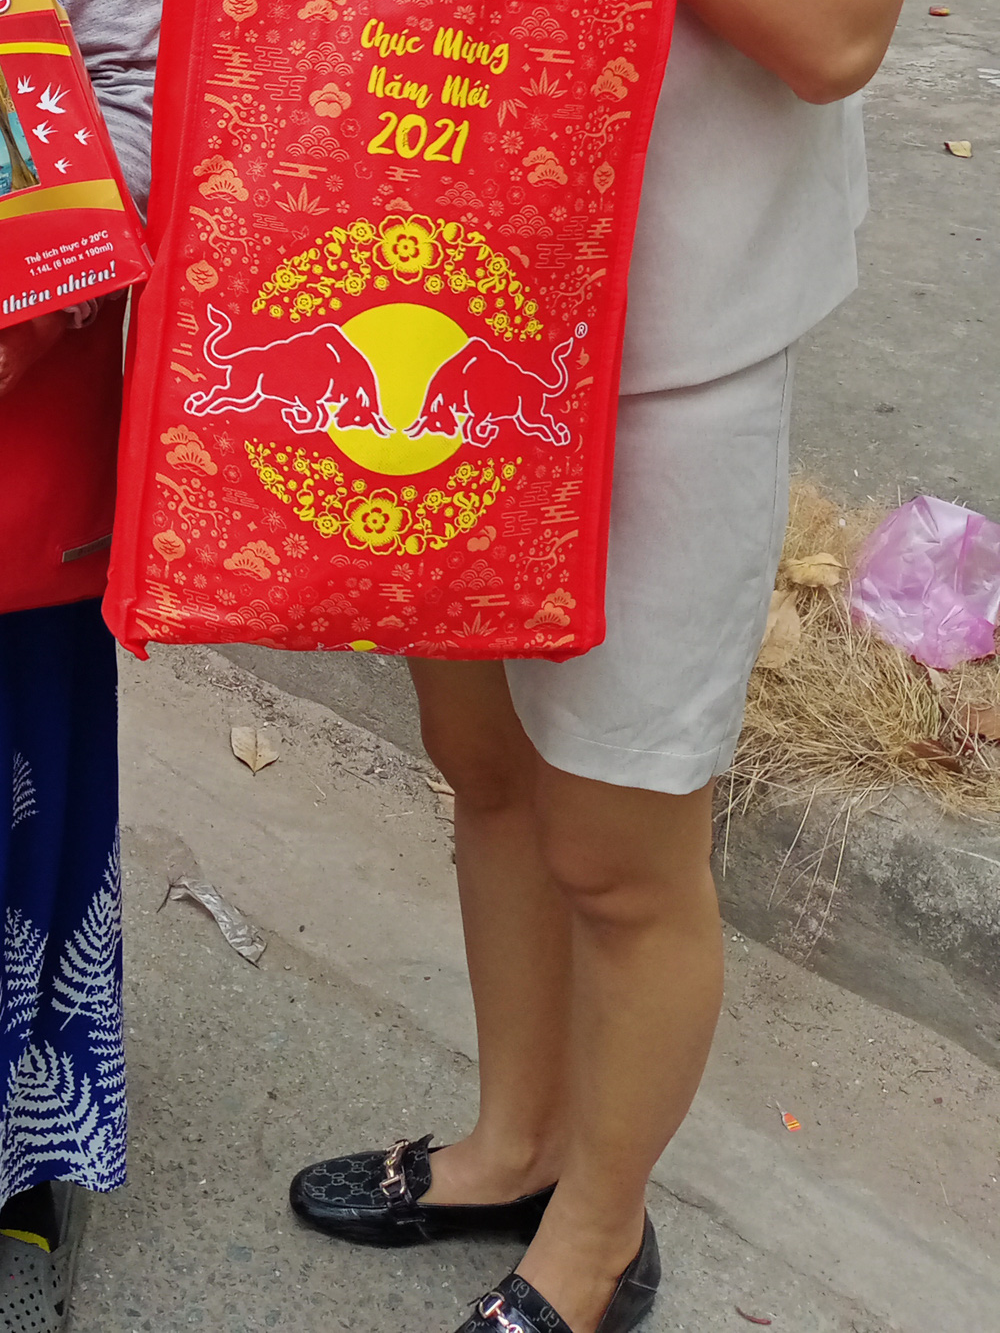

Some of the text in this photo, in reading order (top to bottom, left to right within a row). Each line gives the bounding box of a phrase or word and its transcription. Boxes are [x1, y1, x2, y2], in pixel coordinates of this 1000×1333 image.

[361, 18, 509, 75] Chúc Mừng
[367, 65, 493, 109] Năm Mới
[367, 111, 470, 164] 2021
[24, 252, 41, 265] Thể
[42, 248, 59, 259] tích
[29, 264, 52, 277] 1.14L
[62, 256, 77, 266] lon
[2, 289, 51, 315] thiên
[56, 260, 117, 297] nhiên!
